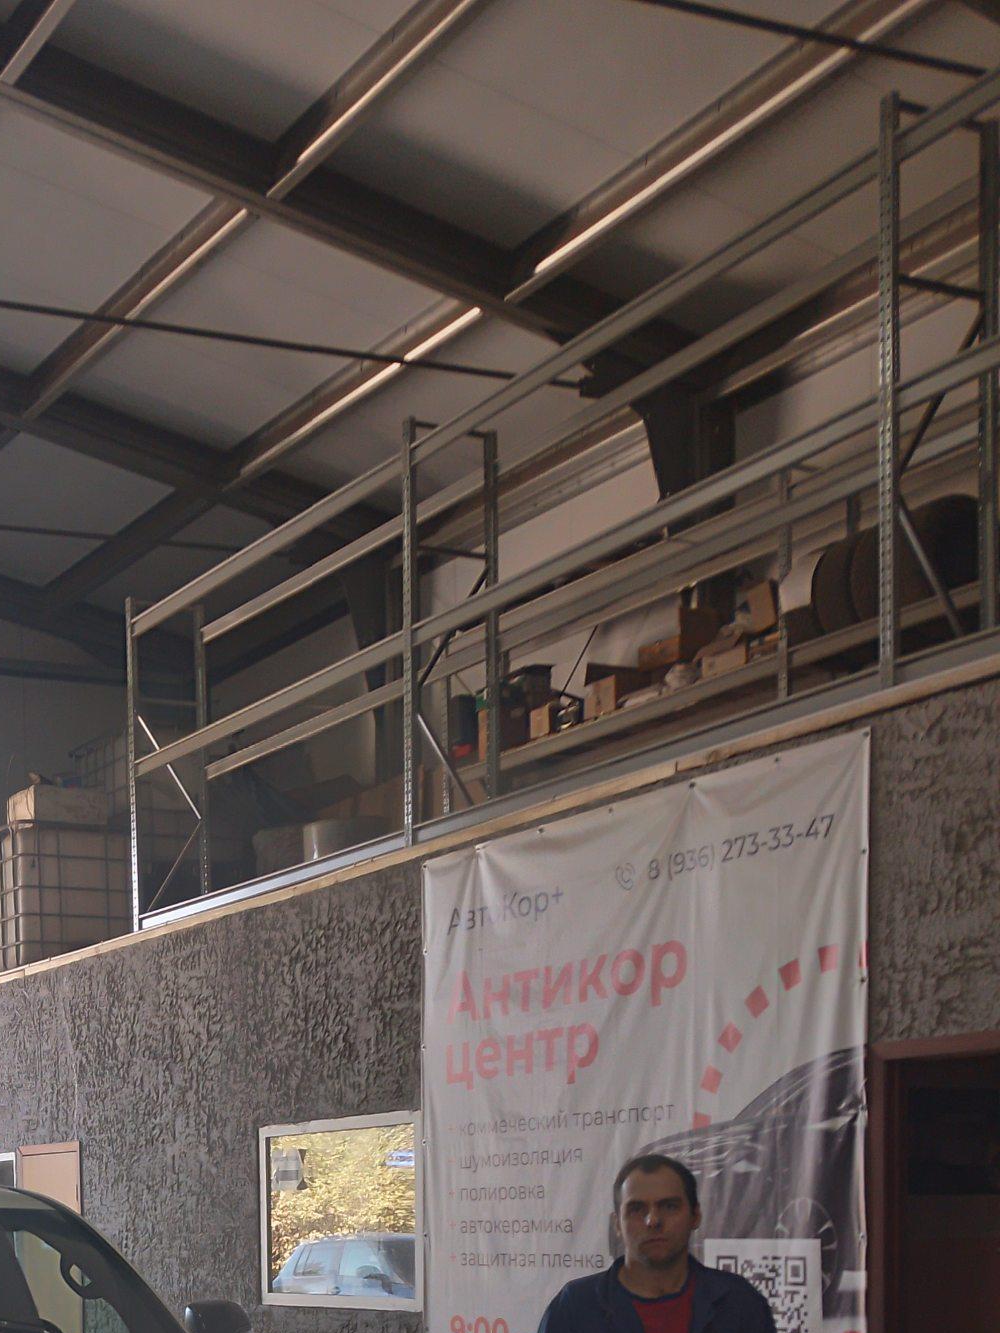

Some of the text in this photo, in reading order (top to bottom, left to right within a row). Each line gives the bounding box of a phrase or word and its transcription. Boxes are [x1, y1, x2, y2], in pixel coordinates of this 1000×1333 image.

[648, 814, 835, 882] 8 (936) 273-33-47
[447, 886, 564, 936] АвтКор+
[446, 938, 688, 1026] Антикор
[445, 1022, 600, 1091] центр
[572, 1103, 675, 1131] транспорт
[460, 1146, 583, 1173] шумоизоляция
[460, 1183, 546, 1202] полировка
[460, 1217, 574, 1239] автокерамика
[460, 1251, 605, 1270] защитная пленка
